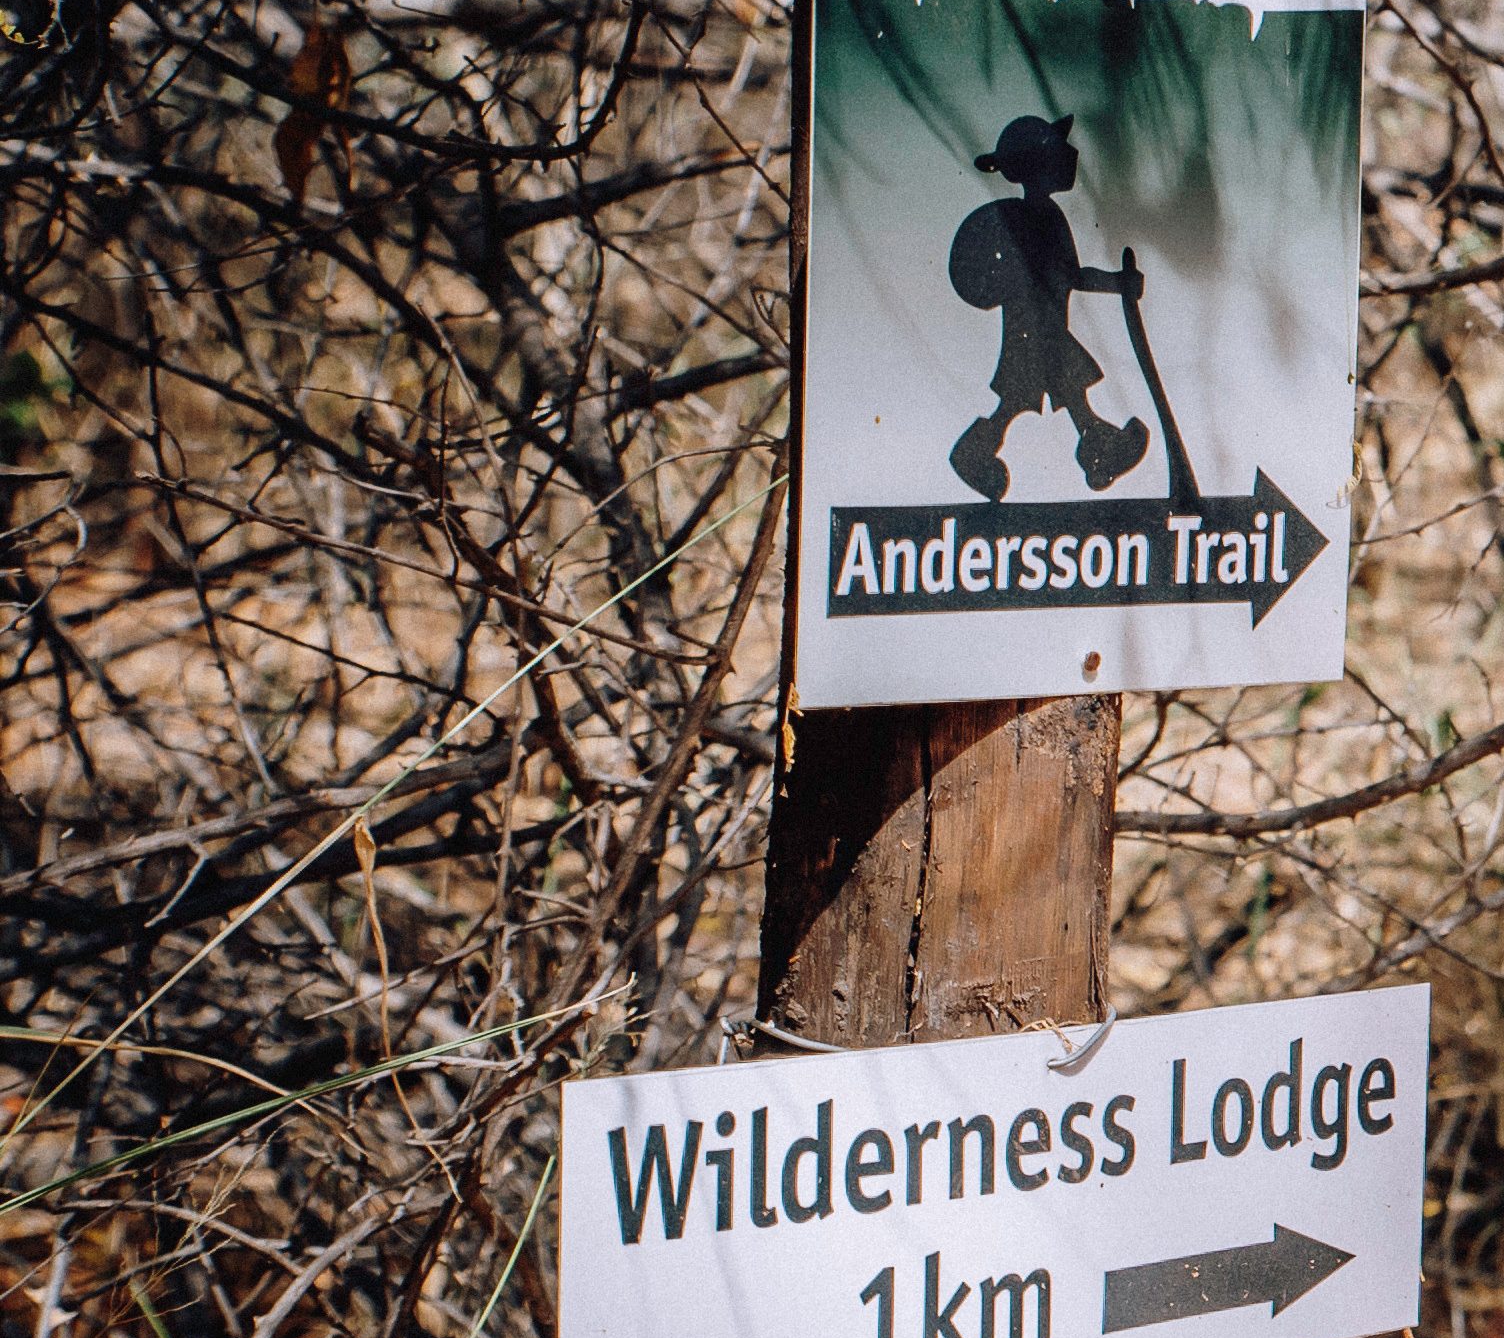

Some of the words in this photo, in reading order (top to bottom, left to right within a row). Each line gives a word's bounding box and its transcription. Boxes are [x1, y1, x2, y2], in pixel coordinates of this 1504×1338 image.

[835, 516, 1150, 597] Andersson
[1167, 510, 1290, 586] Trail
[607, 1092, 1137, 1246] Wilderness
[1169, 1037, 1397, 1172] Lodge
